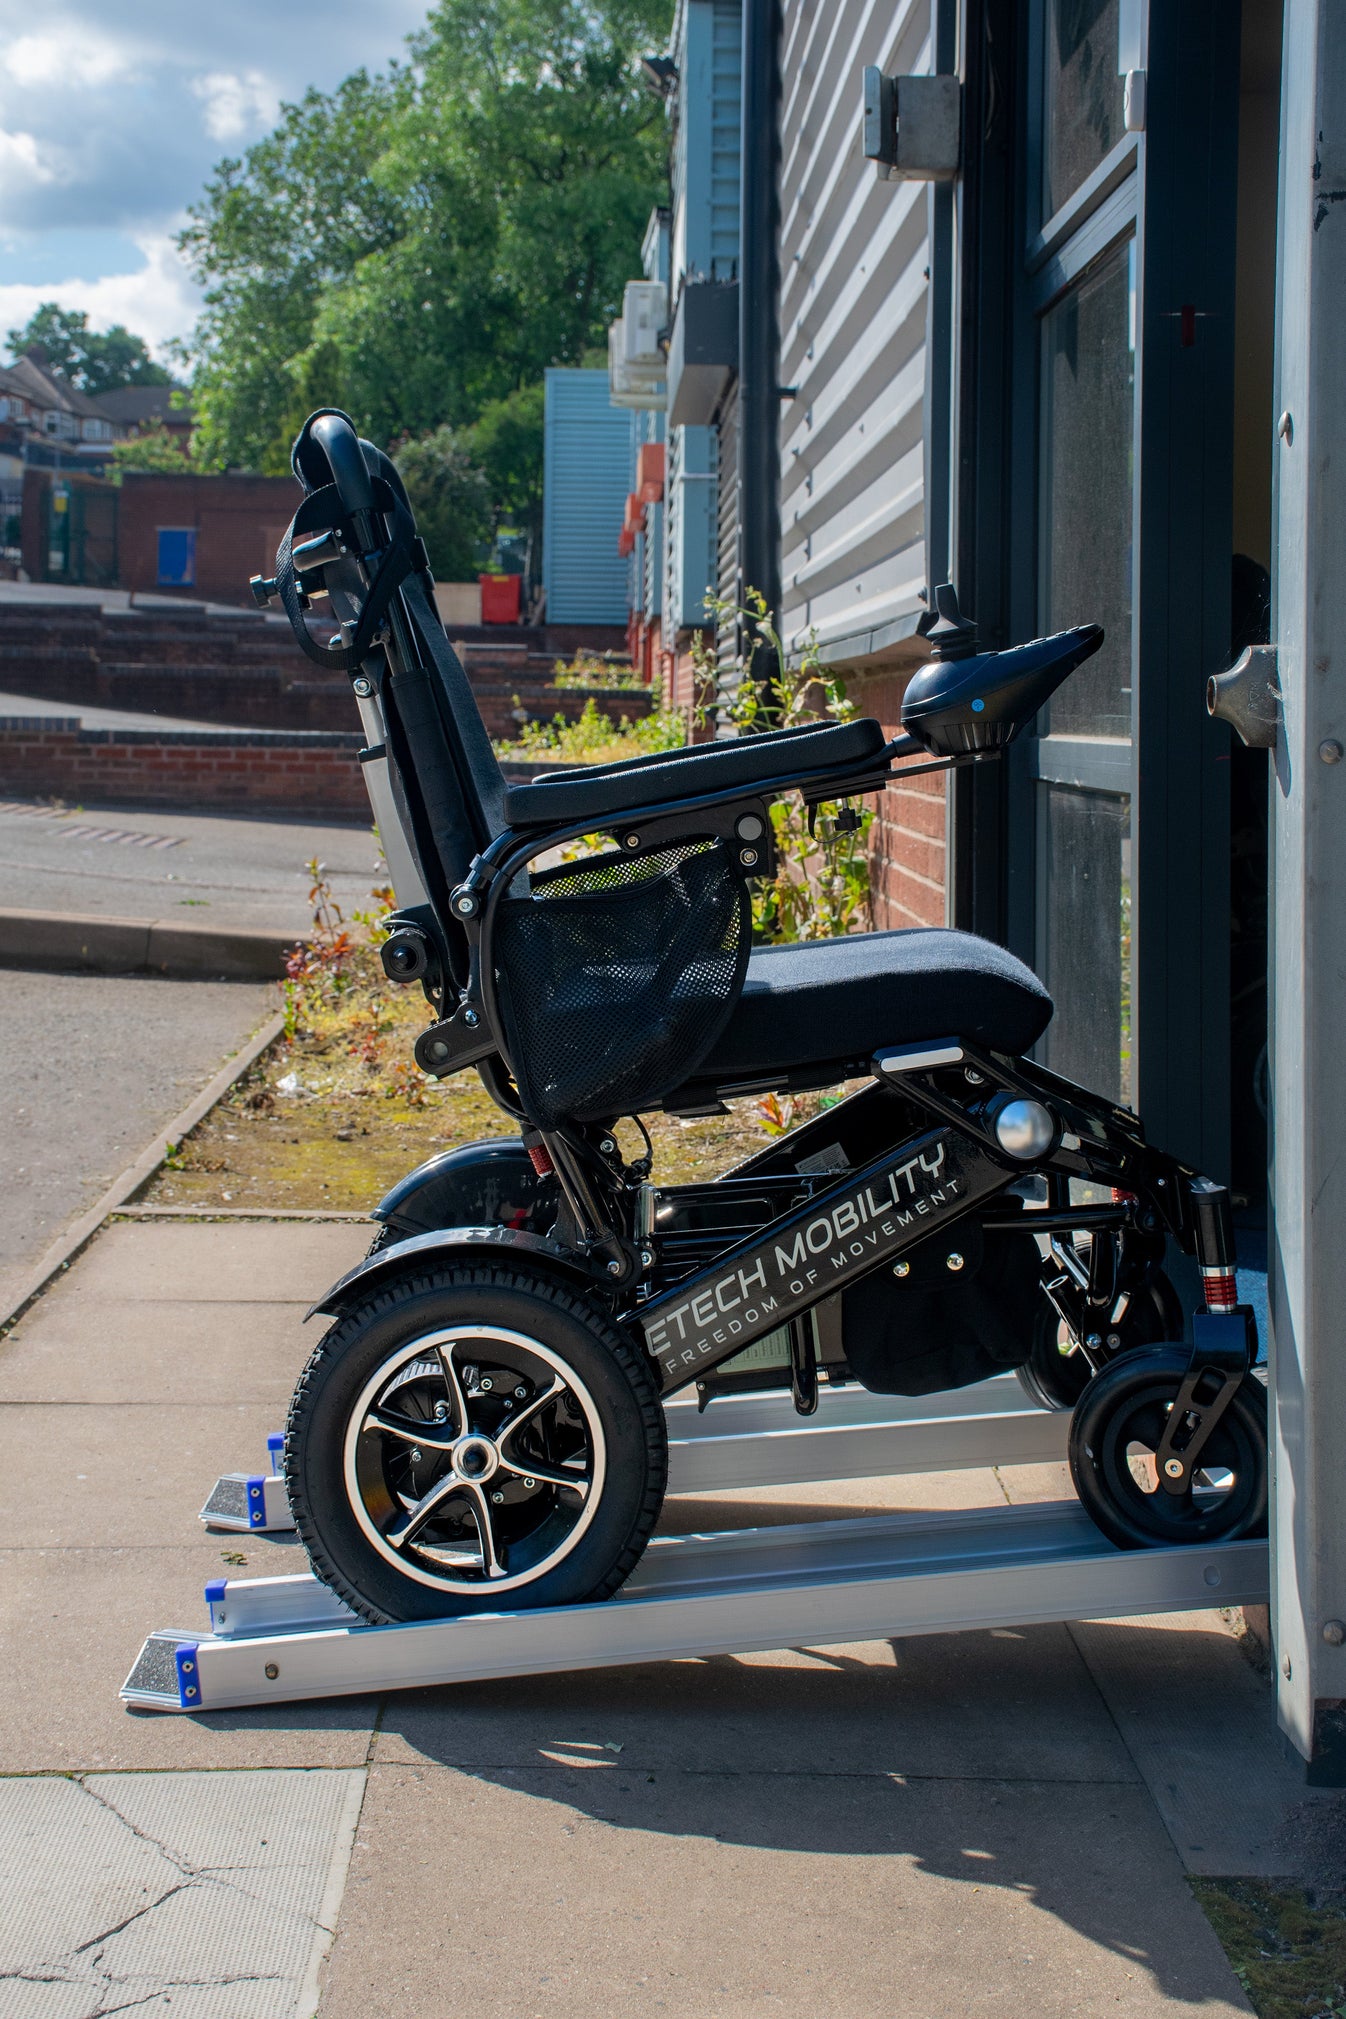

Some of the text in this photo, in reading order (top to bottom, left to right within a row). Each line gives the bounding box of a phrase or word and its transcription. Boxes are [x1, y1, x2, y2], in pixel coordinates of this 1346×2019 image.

[645, 1143, 944, 1356] ETECH MOBILITY
[665, 1296, 778, 1374] FREEDOM
[789, 1268, 818, 1294] OF
[830, 1180, 958, 1268] MOVEMENT
